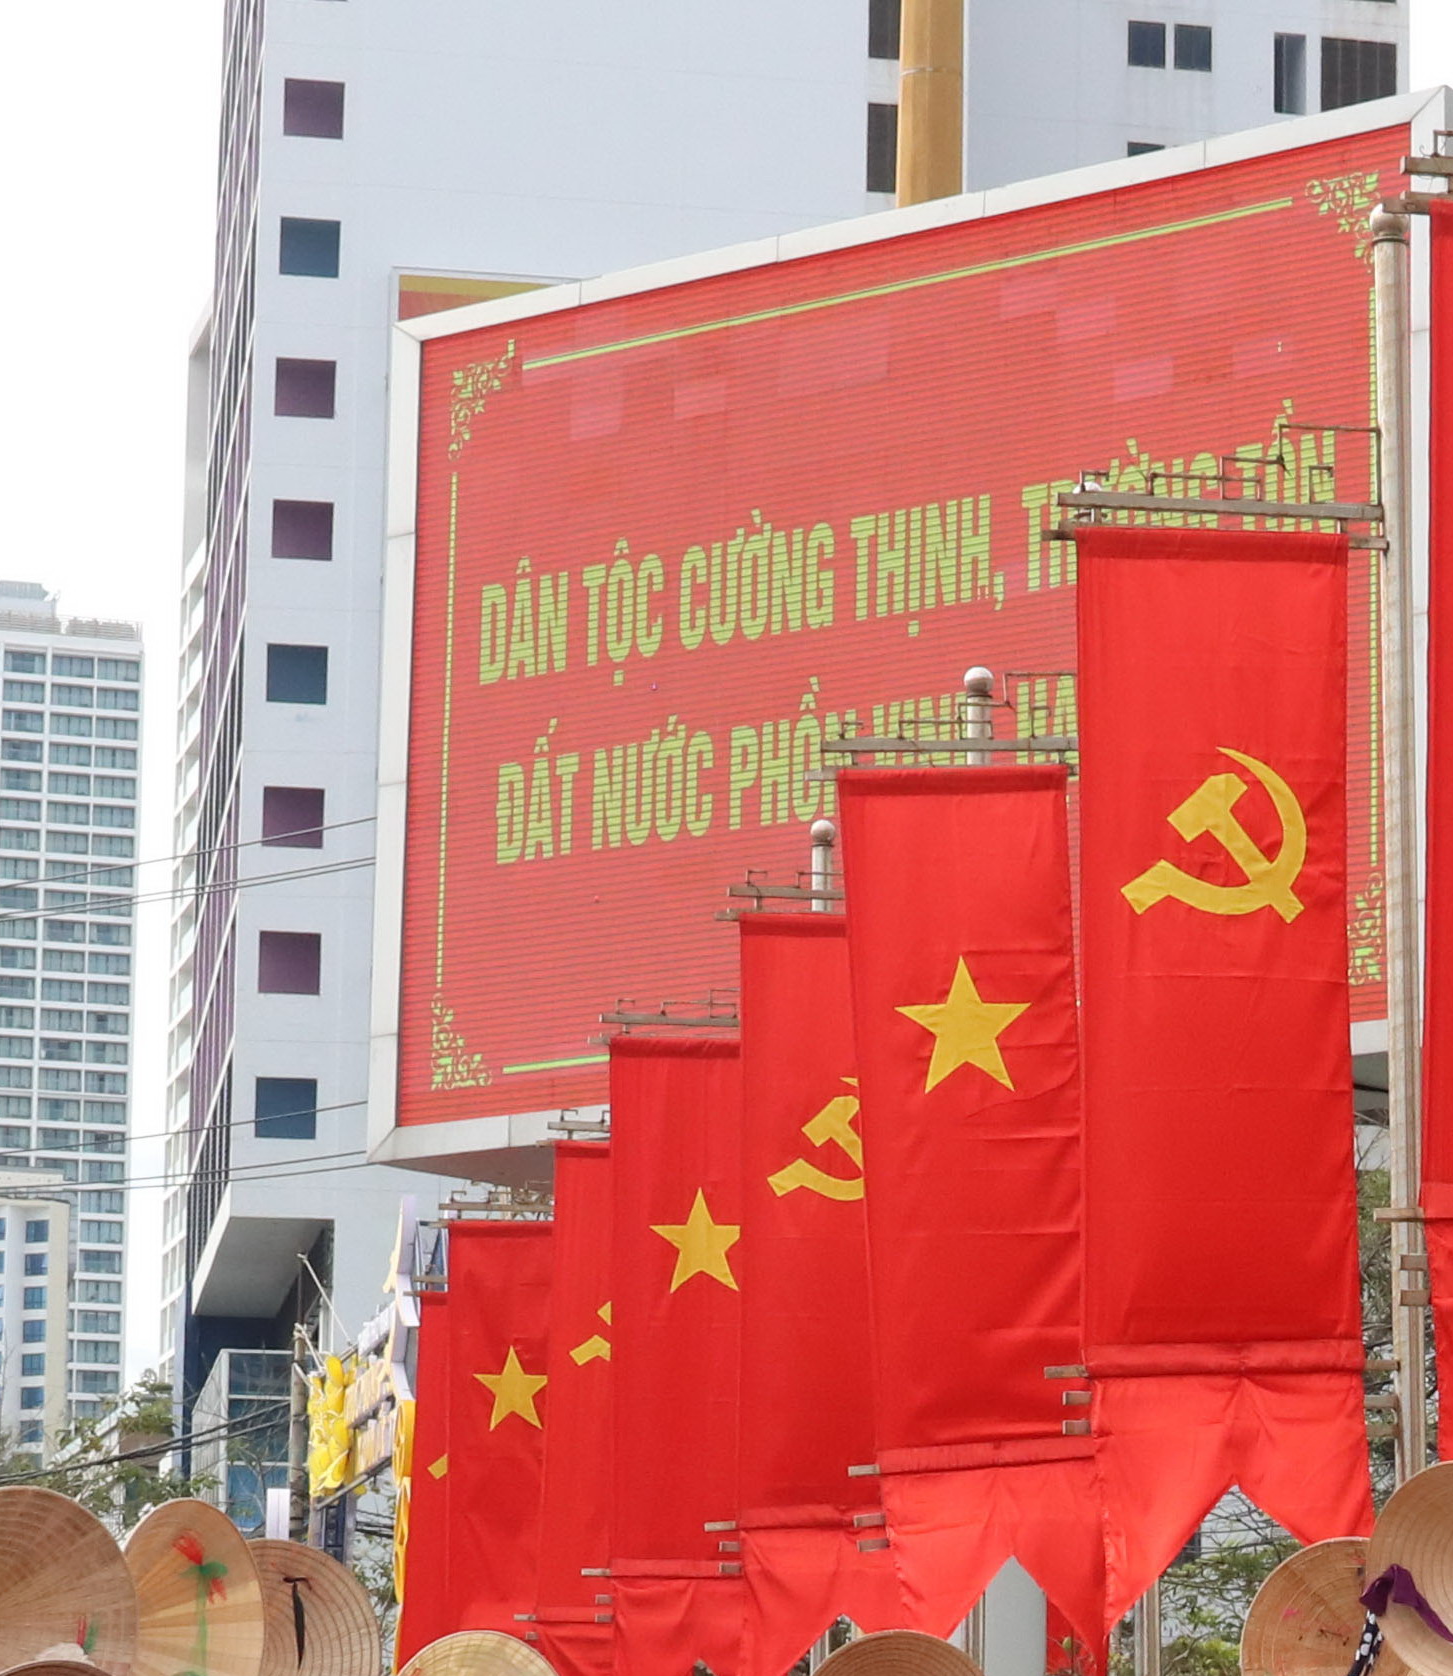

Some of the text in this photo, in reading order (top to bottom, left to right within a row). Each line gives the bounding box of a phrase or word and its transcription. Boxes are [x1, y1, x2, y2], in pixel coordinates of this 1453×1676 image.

[479, 555, 569, 685] DÂN
[582, 537, 664, 686] TỘC
[679, 508, 835, 651] CƯỜNG
[850, 493, 1006, 637] THỊNH,
[496, 717, 580, 866] ĐẤT
[591, 714, 715, 851] NƯỚC
